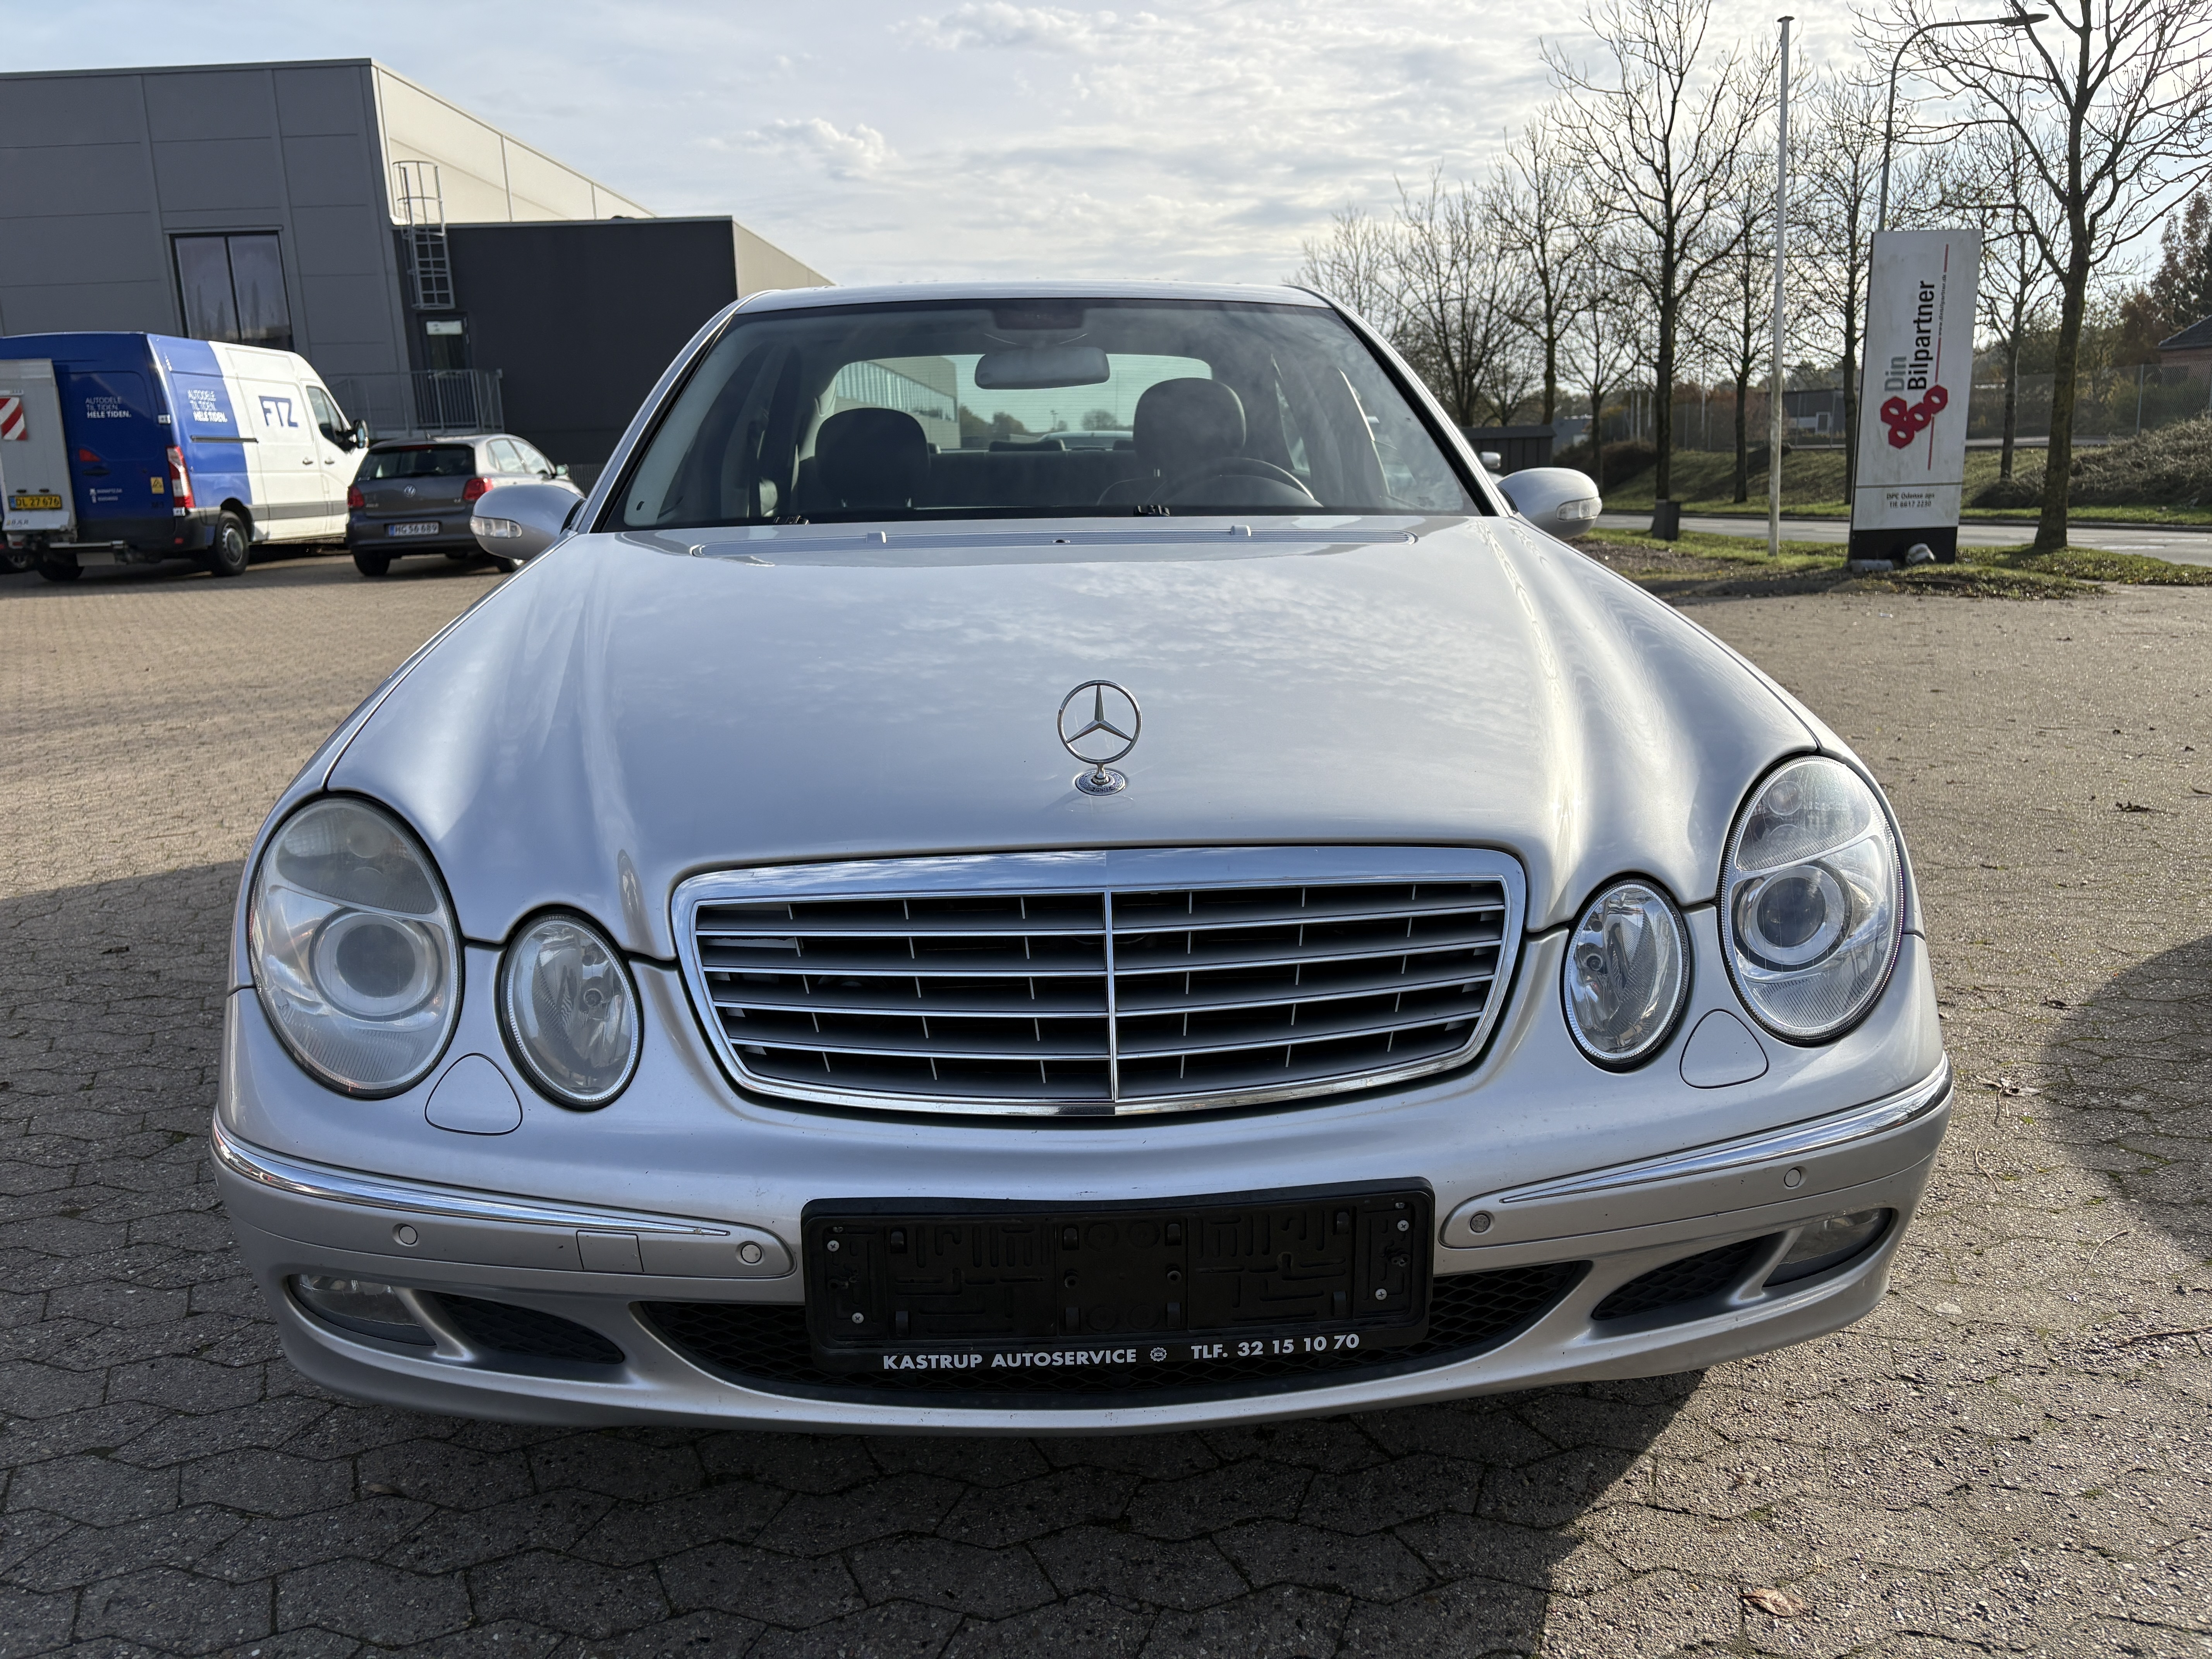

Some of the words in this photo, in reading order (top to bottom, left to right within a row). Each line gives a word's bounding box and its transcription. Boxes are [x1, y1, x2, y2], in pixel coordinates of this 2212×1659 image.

[1907, 280, 1935, 390] Bilpartner
[1884, 356, 1907, 391] Din
[258, 395, 299, 428] FTZ
[30, 498, 39, 507] 27
[883, 1354, 982, 1369] KASTRUP
[991, 1349, 1137, 1367] AUTOSERVICE
[1191, 1344, 1228, 1359] TLF.
[1237, 1341, 1263, 1357] 32
[1273, 1339, 1294, 1354] 15
[1304, 1336, 1327, 1352] 10
[1333, 1334, 1359, 1350] 70
